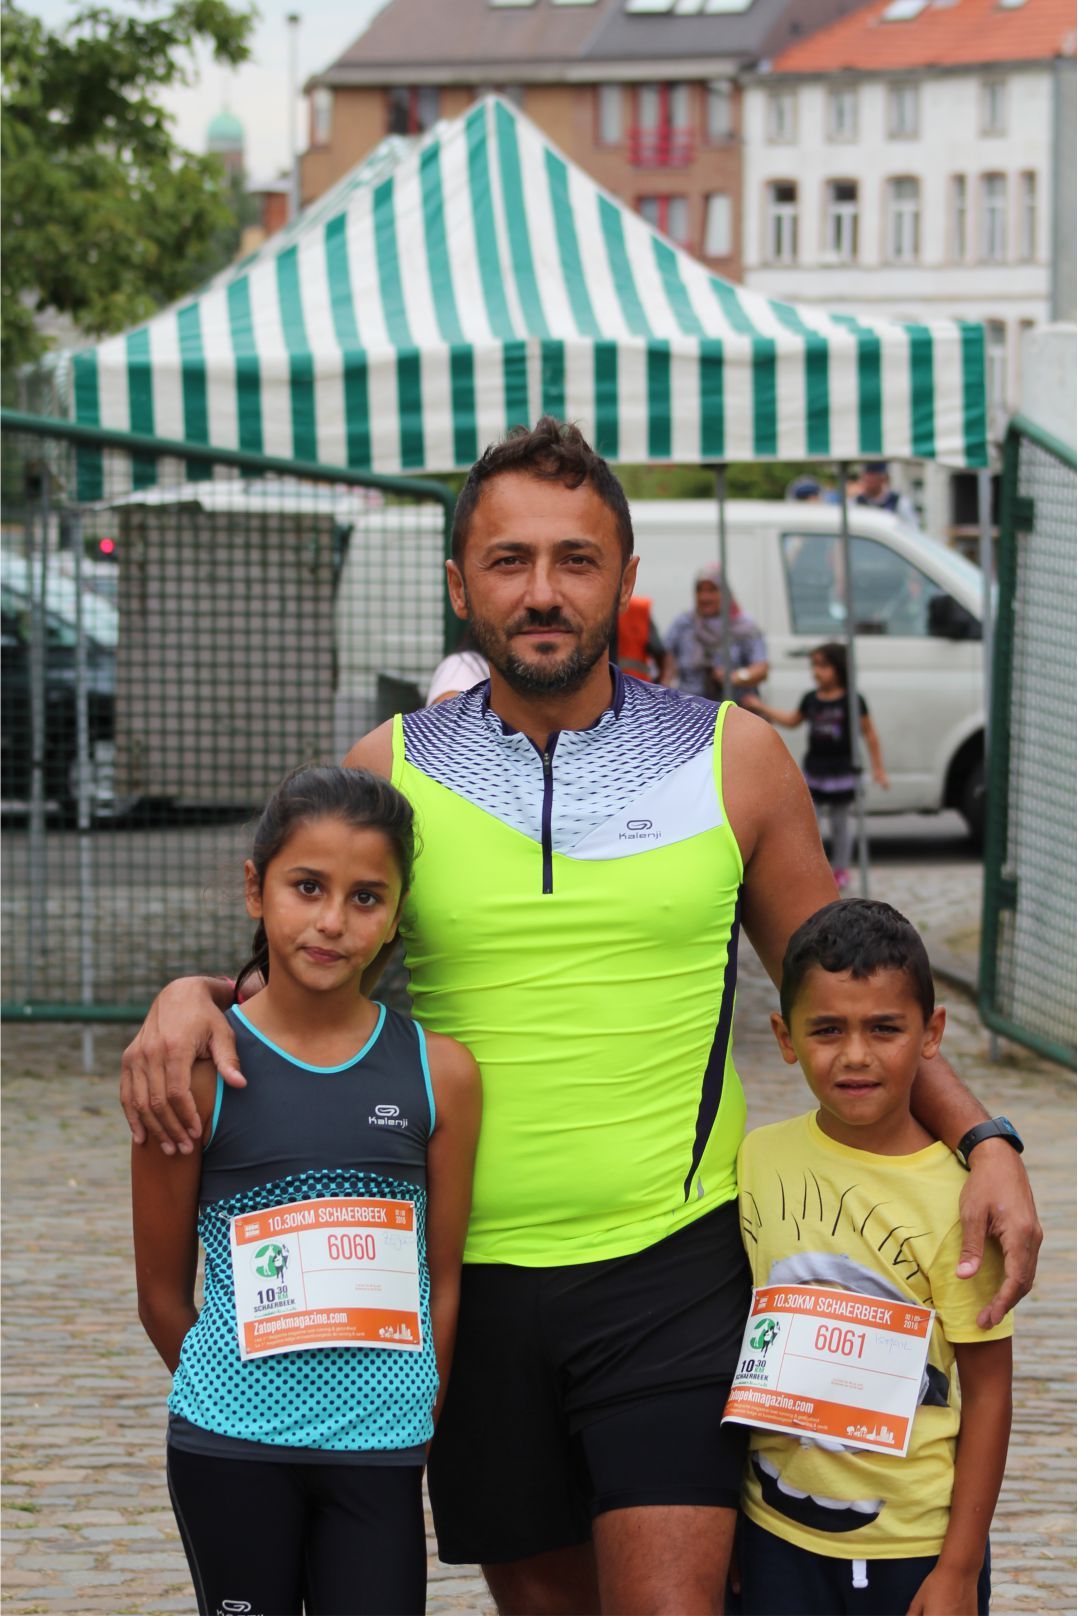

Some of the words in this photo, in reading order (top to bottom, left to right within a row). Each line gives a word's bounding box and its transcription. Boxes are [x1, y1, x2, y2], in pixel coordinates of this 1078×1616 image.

[618, 831, 662, 840] Kalenji
[368, 1116, 408, 1129] Kalenji
[268, 1211, 315, 1232] 10.30KM
[318, 1207, 387, 1223] SCHAERBEEK
[327, 1234, 376, 1261] 6060
[253, 1299, 295, 1313] SCHAERBEEK
[772, 1293, 815, 1310] 10.30KM
[816, 1297, 894, 1325] SCHAERBEEK
[254, 1312, 348, 1336] Zatopekmagazine.com
[814, 1324, 867, 1359] 6061
